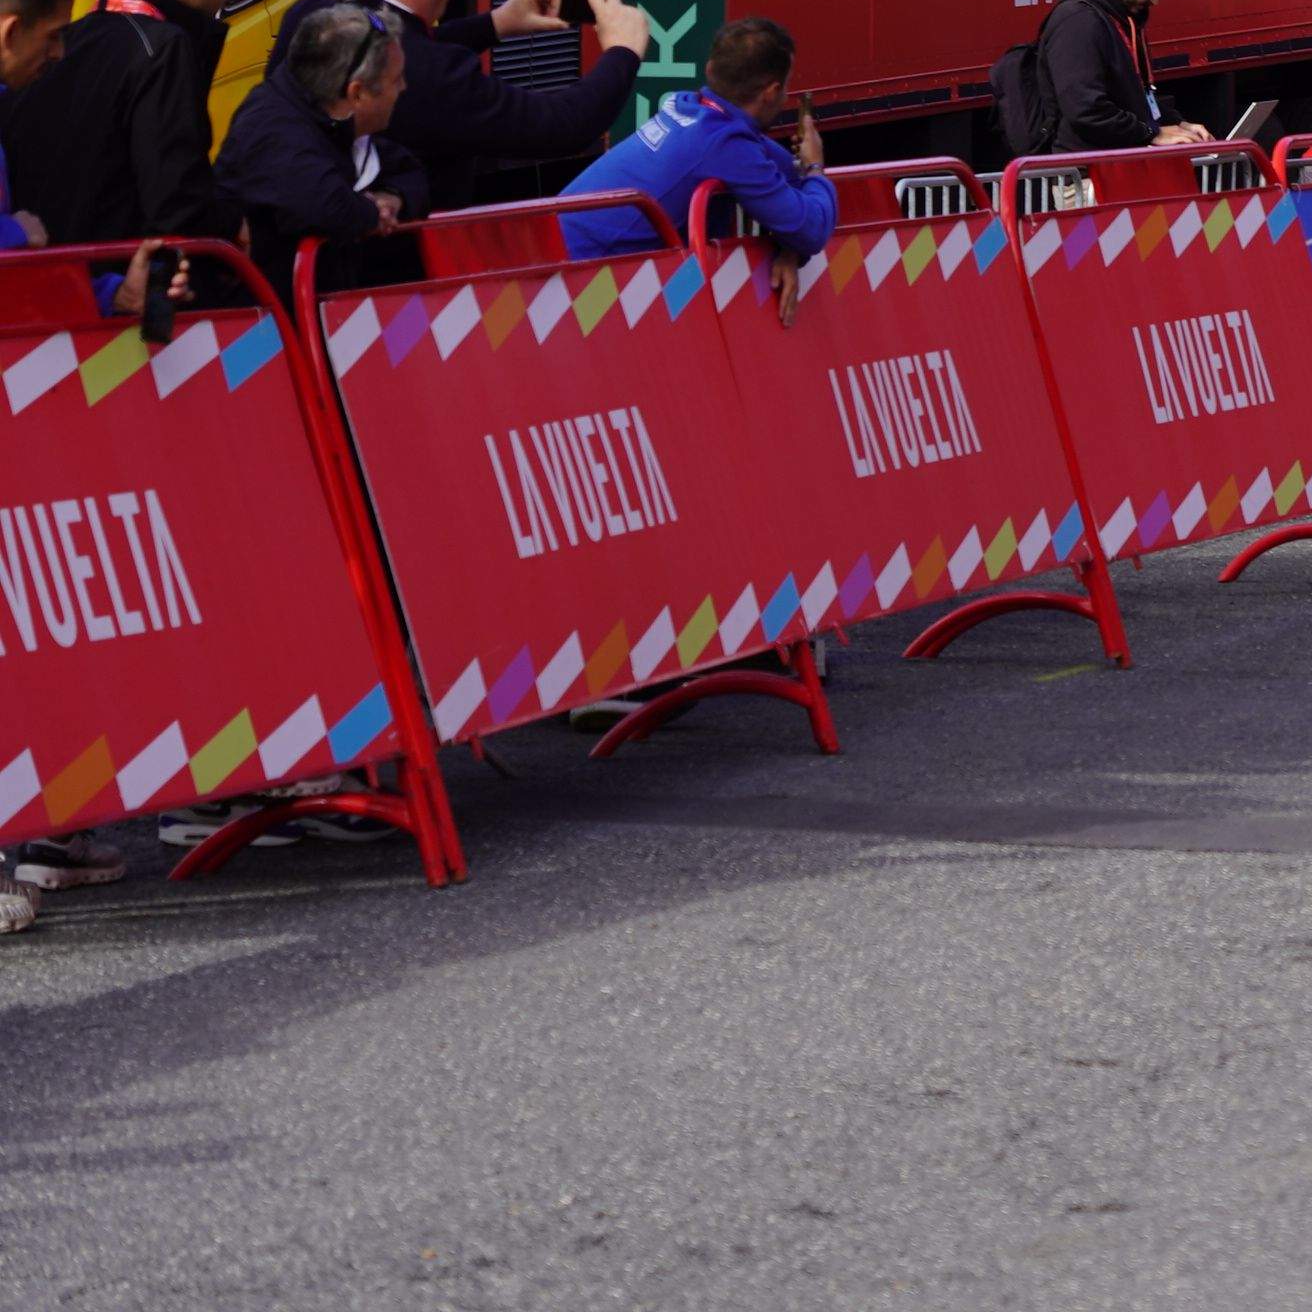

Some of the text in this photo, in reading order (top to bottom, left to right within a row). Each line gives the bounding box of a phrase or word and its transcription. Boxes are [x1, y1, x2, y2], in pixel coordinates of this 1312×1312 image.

[827, 348, 983, 479] LA VUELTA
[1131, 309, 1276, 426] LA VUELTA
[483, 405, 679, 561] LA VUELTA
